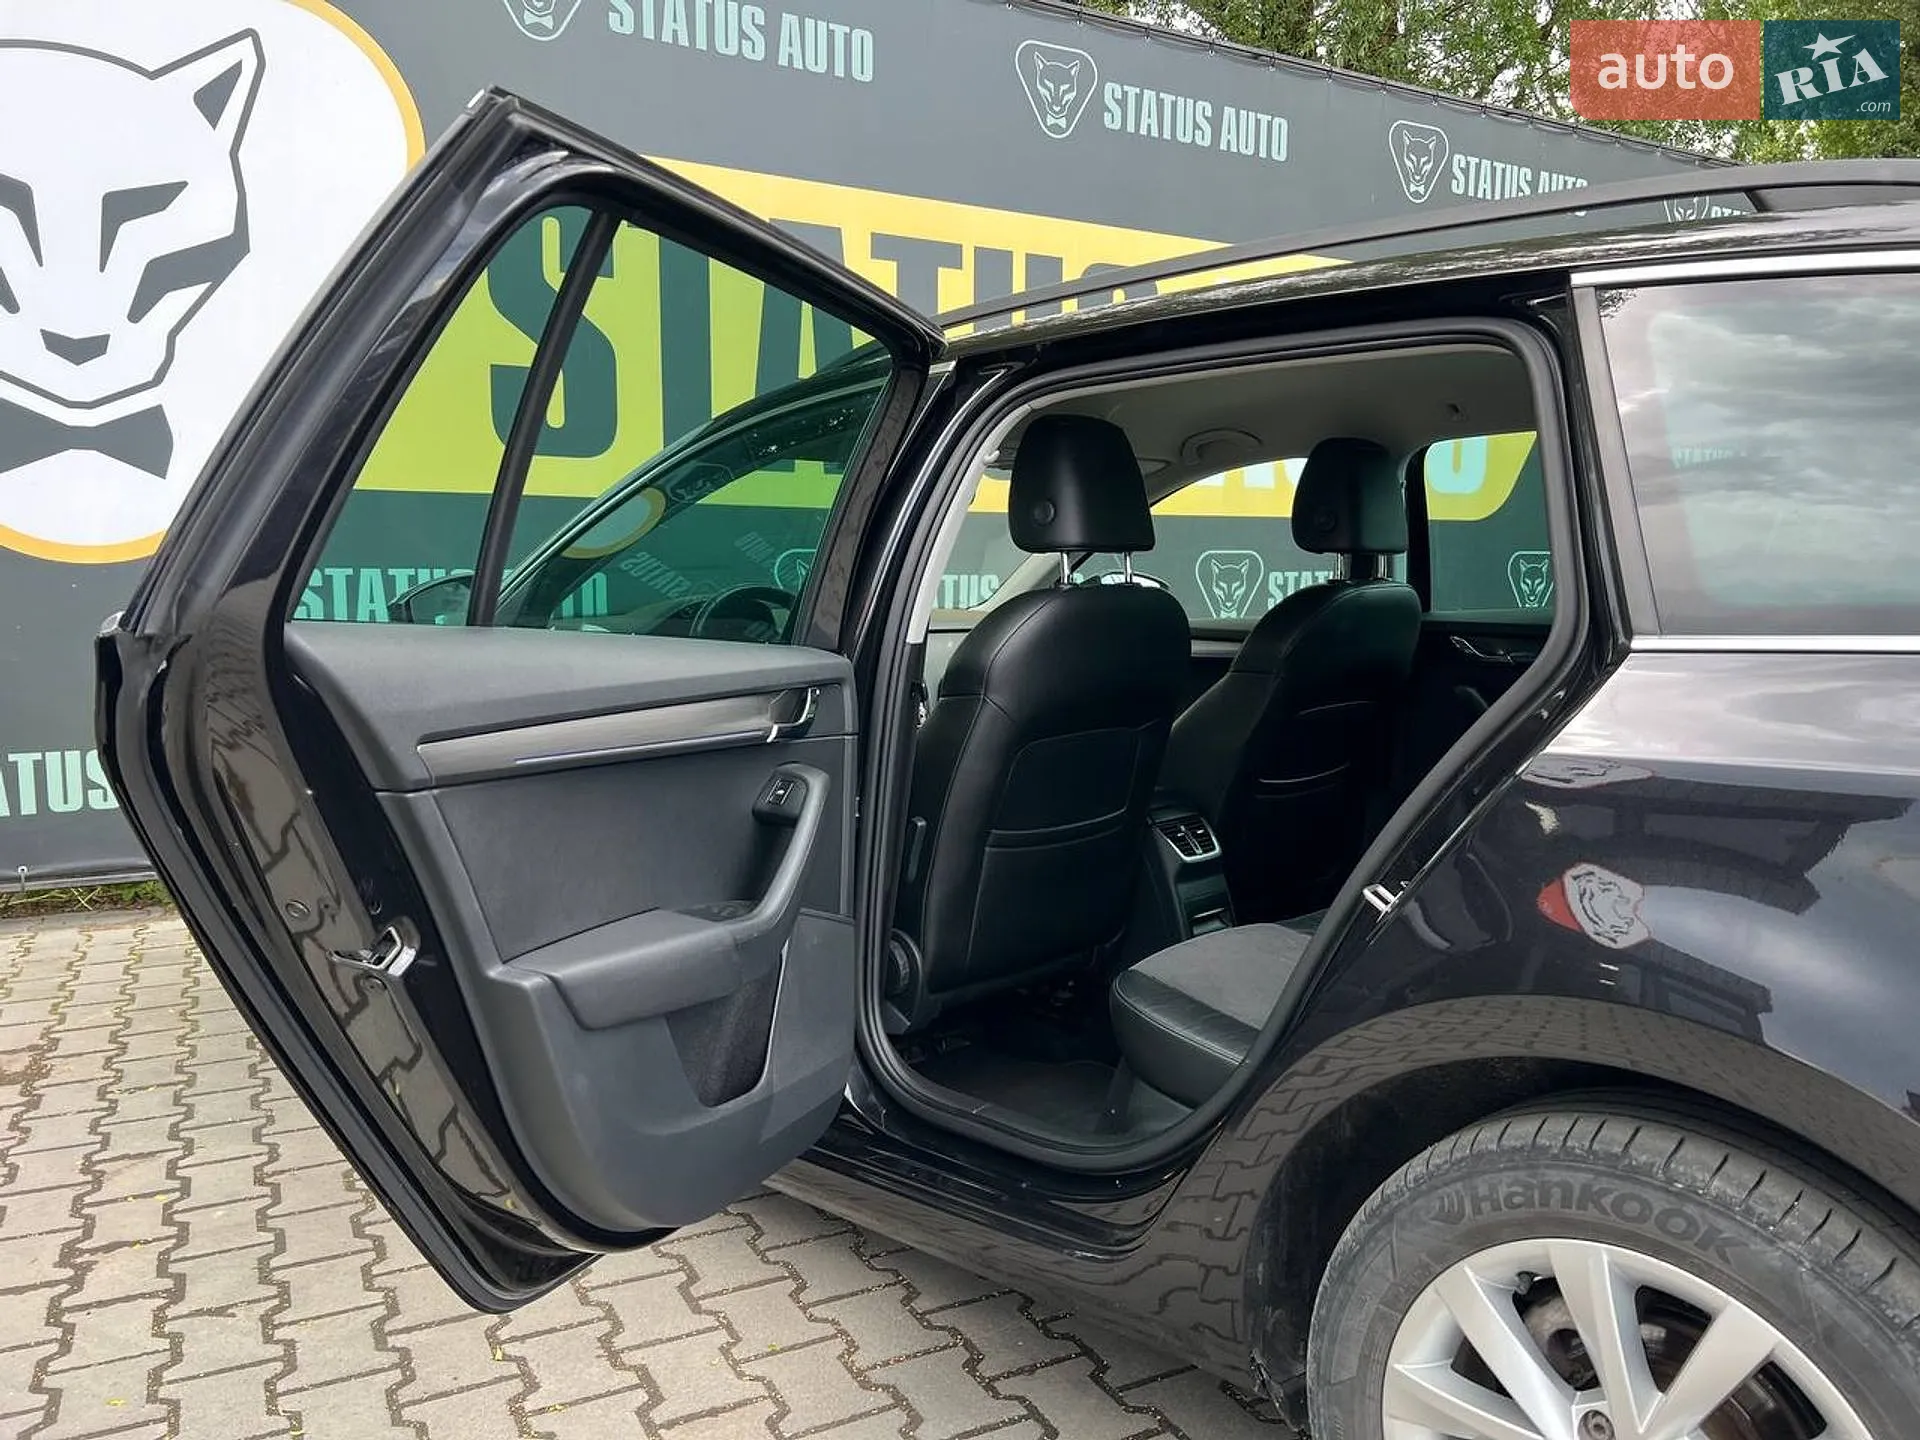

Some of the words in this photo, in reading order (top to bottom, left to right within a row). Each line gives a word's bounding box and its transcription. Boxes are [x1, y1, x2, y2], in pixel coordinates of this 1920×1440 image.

[777, 12, 874, 83] AUTO
[1103, 82, 1212, 147] STATUS
[1219, 106, 1289, 162] AUTO
[1451, 153, 1533, 200] STATUS
